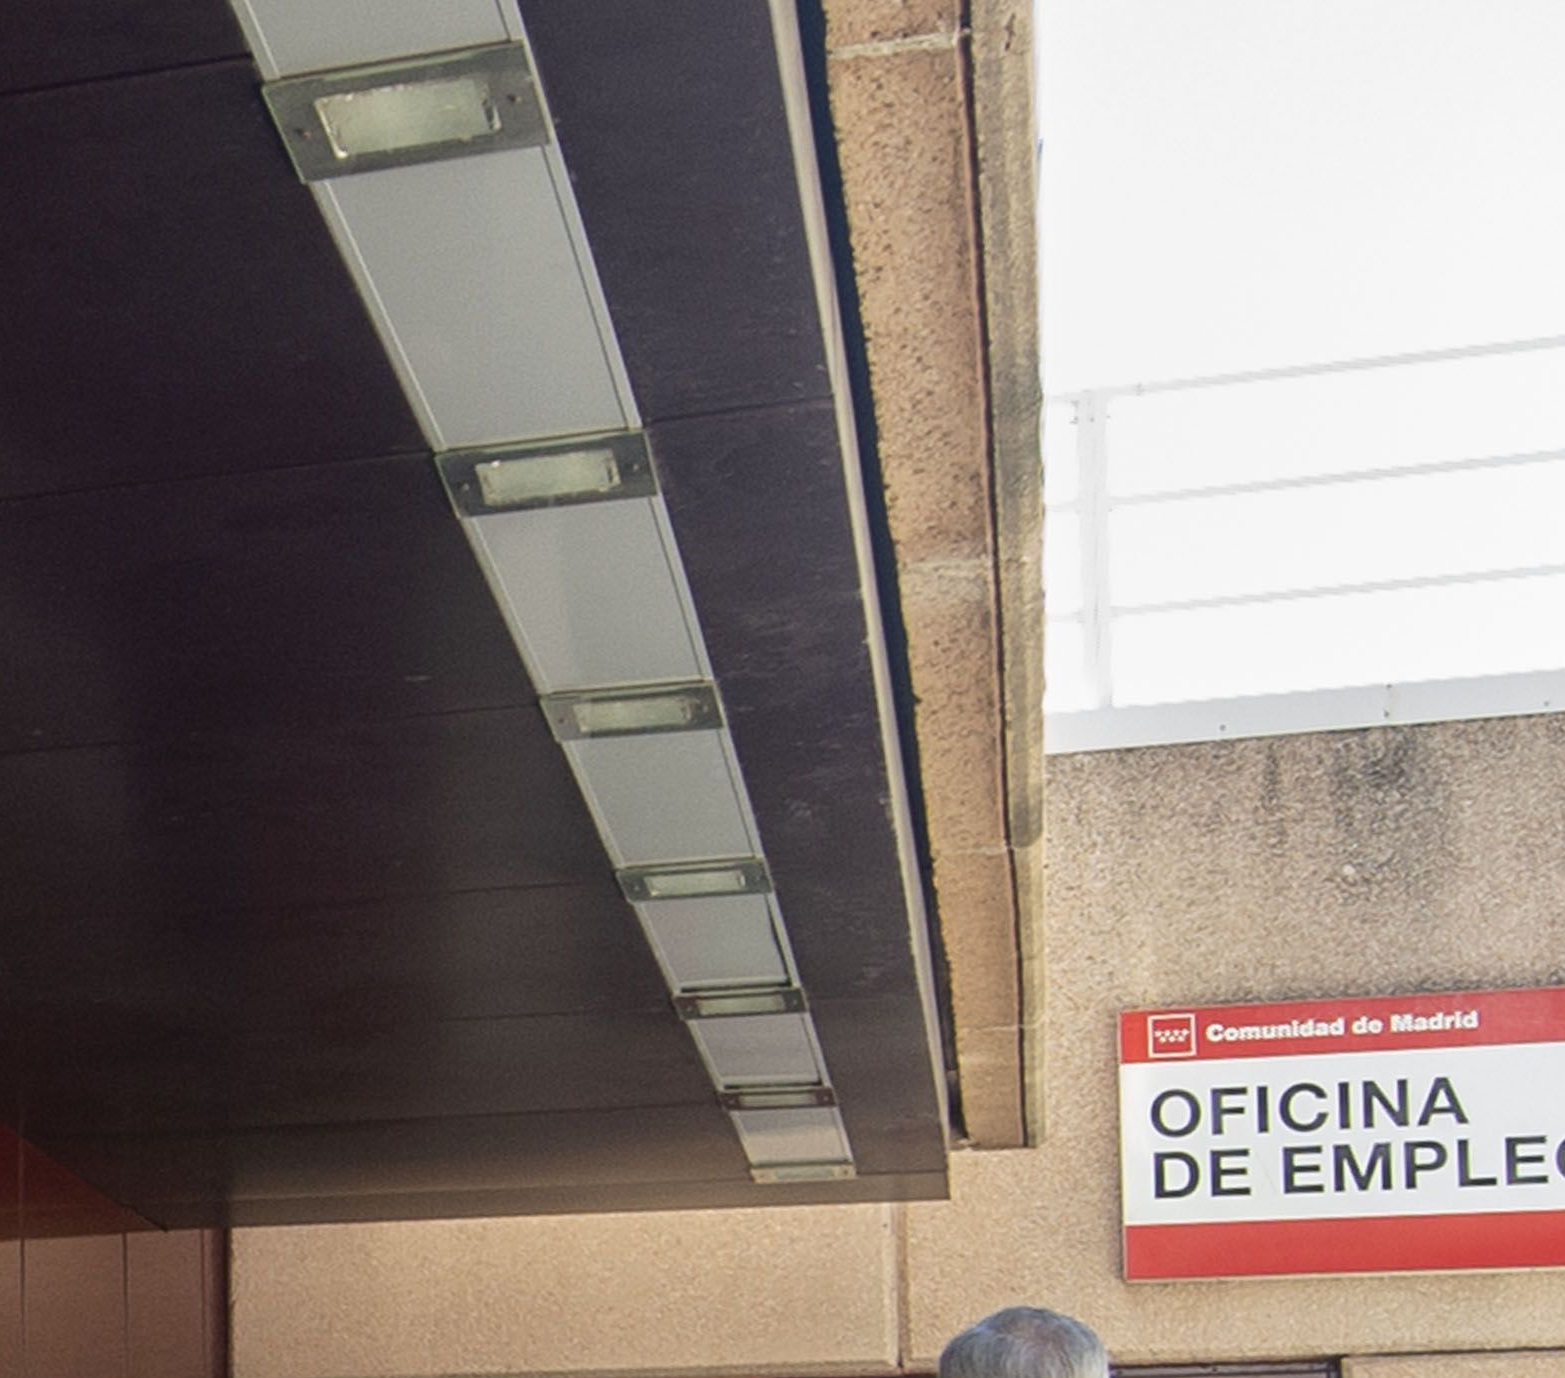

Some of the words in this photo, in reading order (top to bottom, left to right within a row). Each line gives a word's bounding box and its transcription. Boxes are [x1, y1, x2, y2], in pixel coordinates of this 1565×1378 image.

[1206, 1018, 1345, 1043] Comunidad
[1352, 1015, 1383, 1035] de
[1390, 1009, 1479, 1033] Madrid
[1150, 1076, 1469, 1138] OFICINA
[1153, 1147, 1252, 1199] DE
